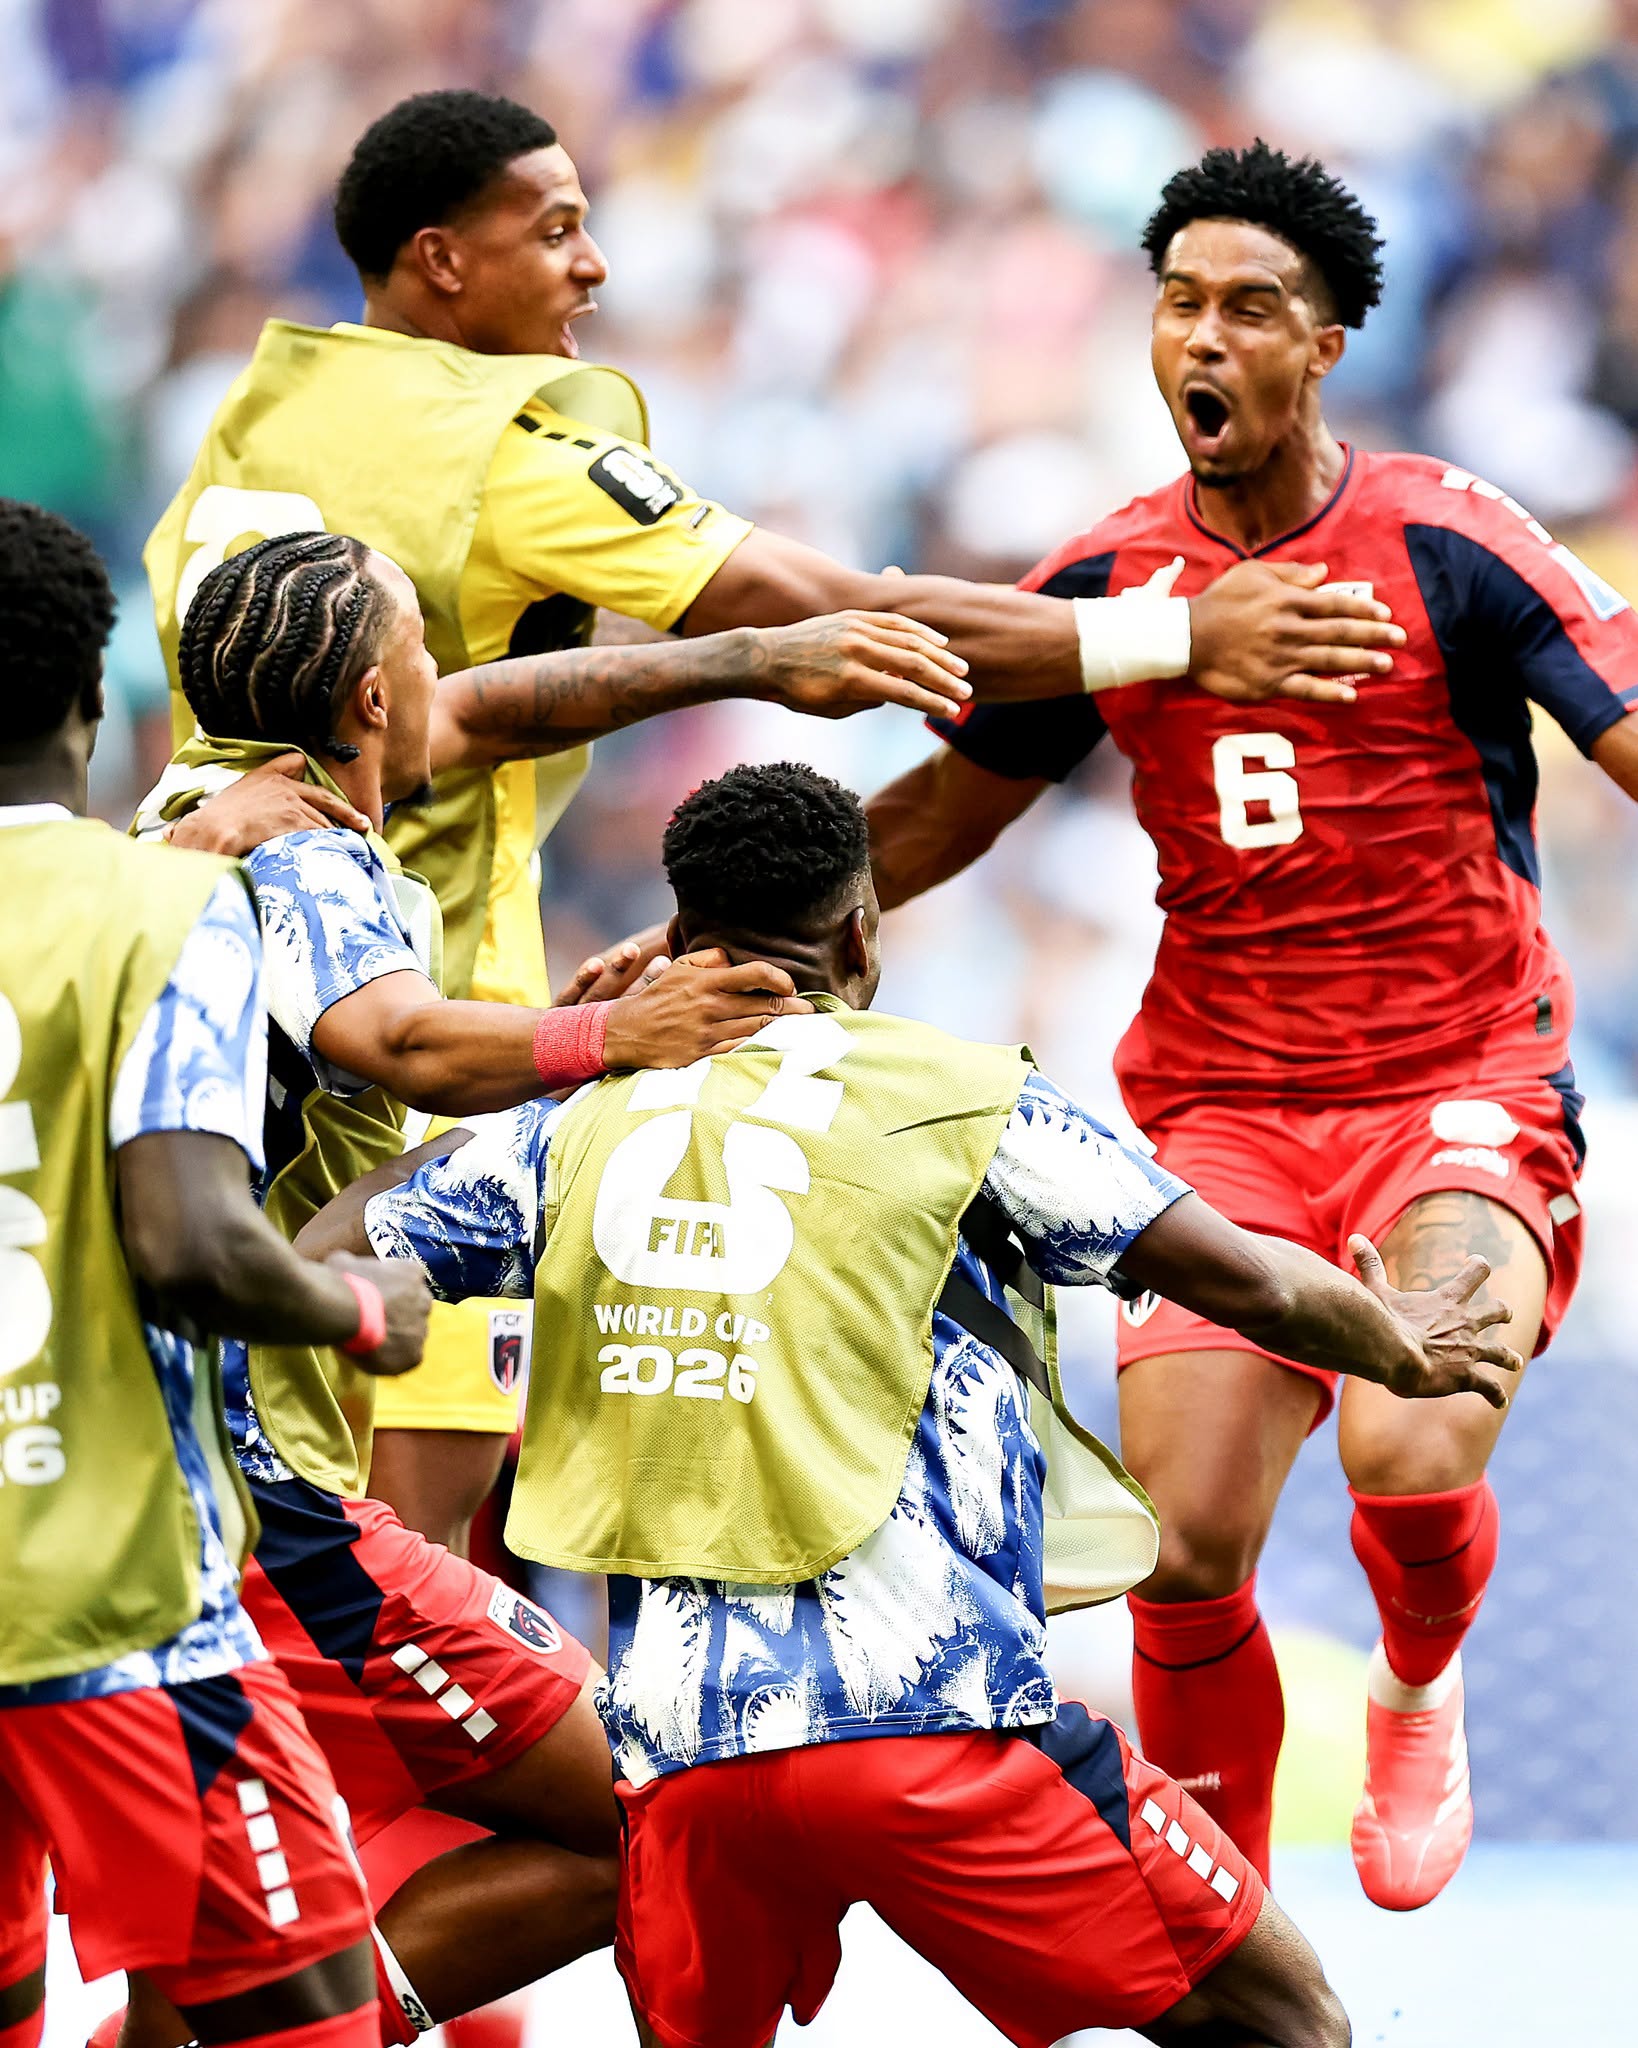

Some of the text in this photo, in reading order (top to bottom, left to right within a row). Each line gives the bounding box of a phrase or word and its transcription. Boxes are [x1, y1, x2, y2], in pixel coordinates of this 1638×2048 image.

[1213, 732, 1304, 850] 6
[647, 1216, 726, 1258] FIFA
[593, 1303, 772, 1346] WORLD CUP
[597, 1343, 760, 1405] 2026
[0, 1382, 62, 1424] UP
